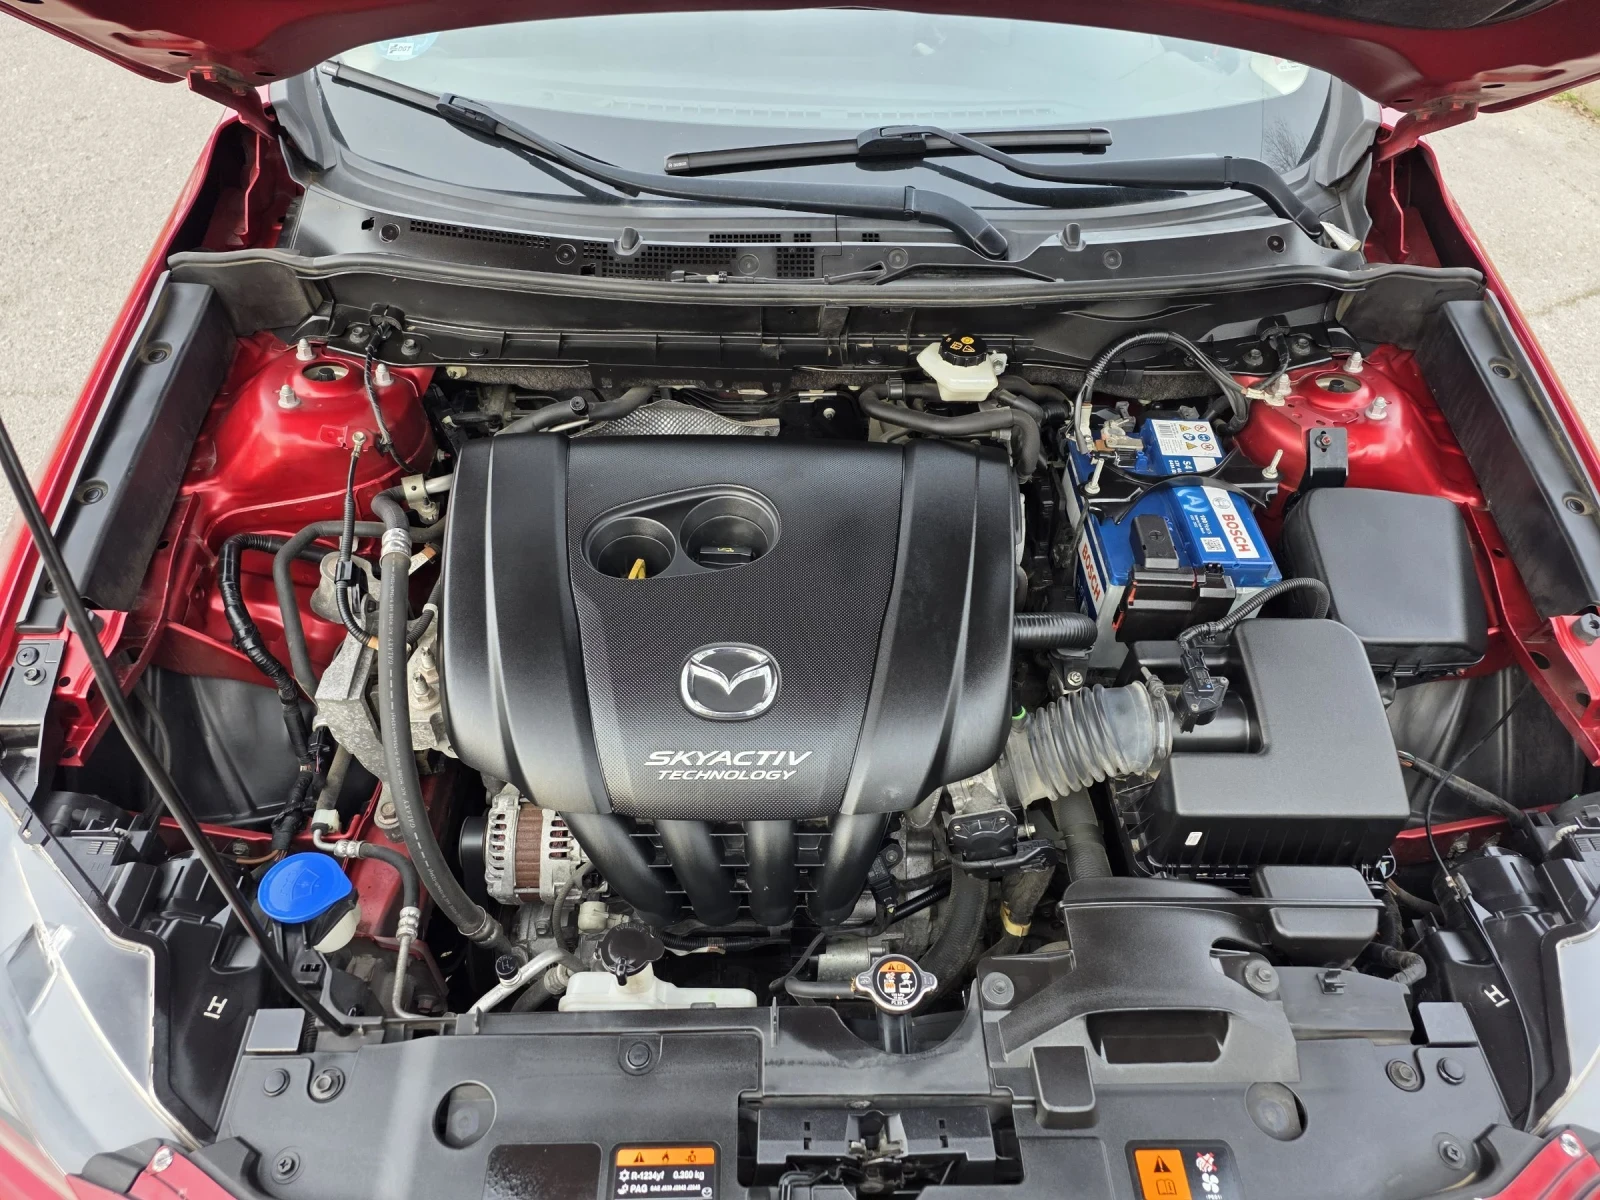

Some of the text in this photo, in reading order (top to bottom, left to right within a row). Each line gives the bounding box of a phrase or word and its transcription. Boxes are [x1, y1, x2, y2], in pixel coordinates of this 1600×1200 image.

[1222, 514, 1251, 552] BOSCH
[1082, 543, 1101, 602] BOSCH
[644, 750, 813, 766] SKYACTIV
[658, 770, 797, 781] TECHNOLOGY
[403, 799, 415, 829] GALAXY
[631, 1170, 665, 1181] R-1234yf
[694, 1170, 705, 1181] kg
[630, 1184, 648, 1194] PAG
